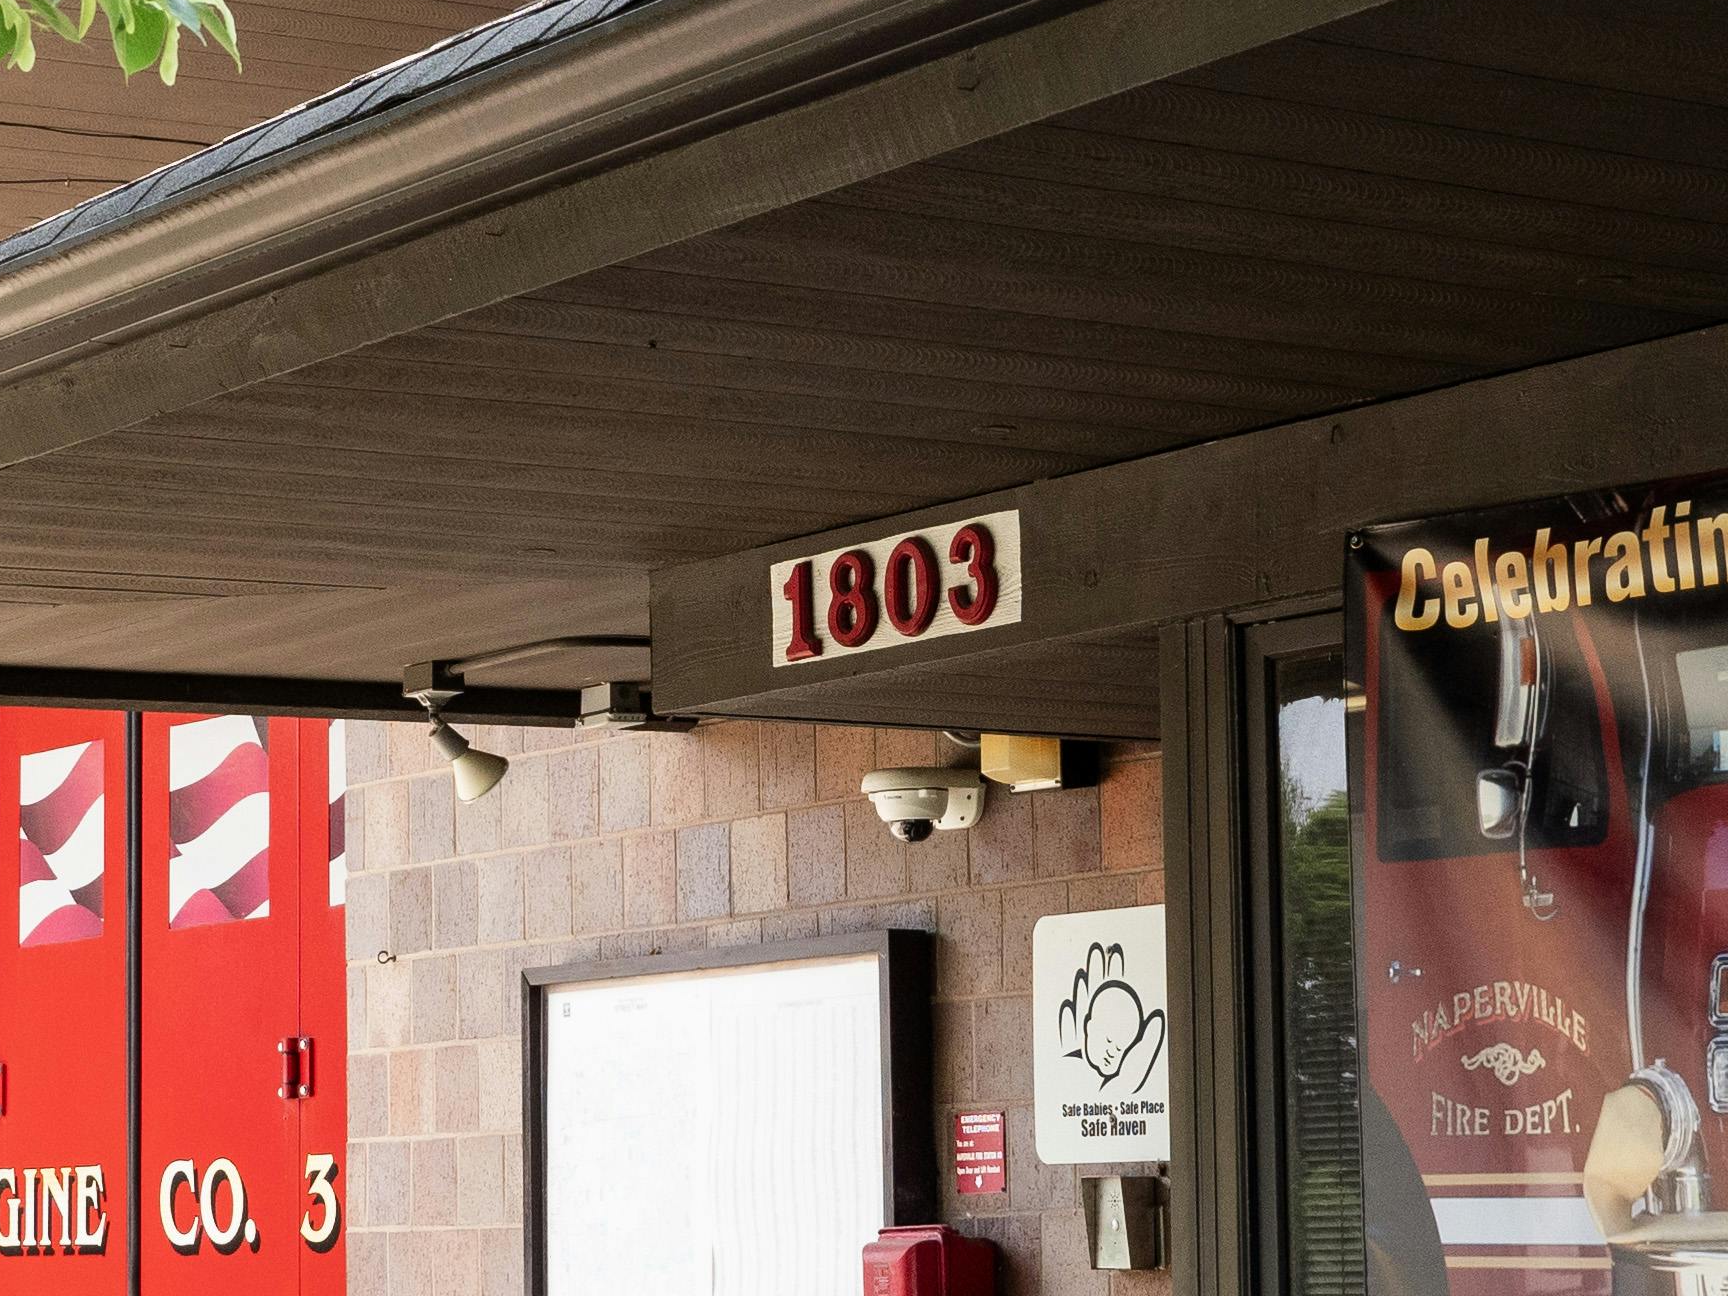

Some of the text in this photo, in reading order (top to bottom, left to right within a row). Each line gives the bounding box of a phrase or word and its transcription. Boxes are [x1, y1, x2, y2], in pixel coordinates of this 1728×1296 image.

[783, 522, 999, 663] 1803
[1411, 980, 1588, 1058] NAPERVILLE
[1062, 1100, 1165, 1117] Safe Babies Safe Place
[1081, 1118, 1107, 1137] Safe
[1431, 1088, 1580, 1136] FIRE DEPT.
[159, 1157, 260, 1252] CO.
[300, 1153, 340, 1249] 3
